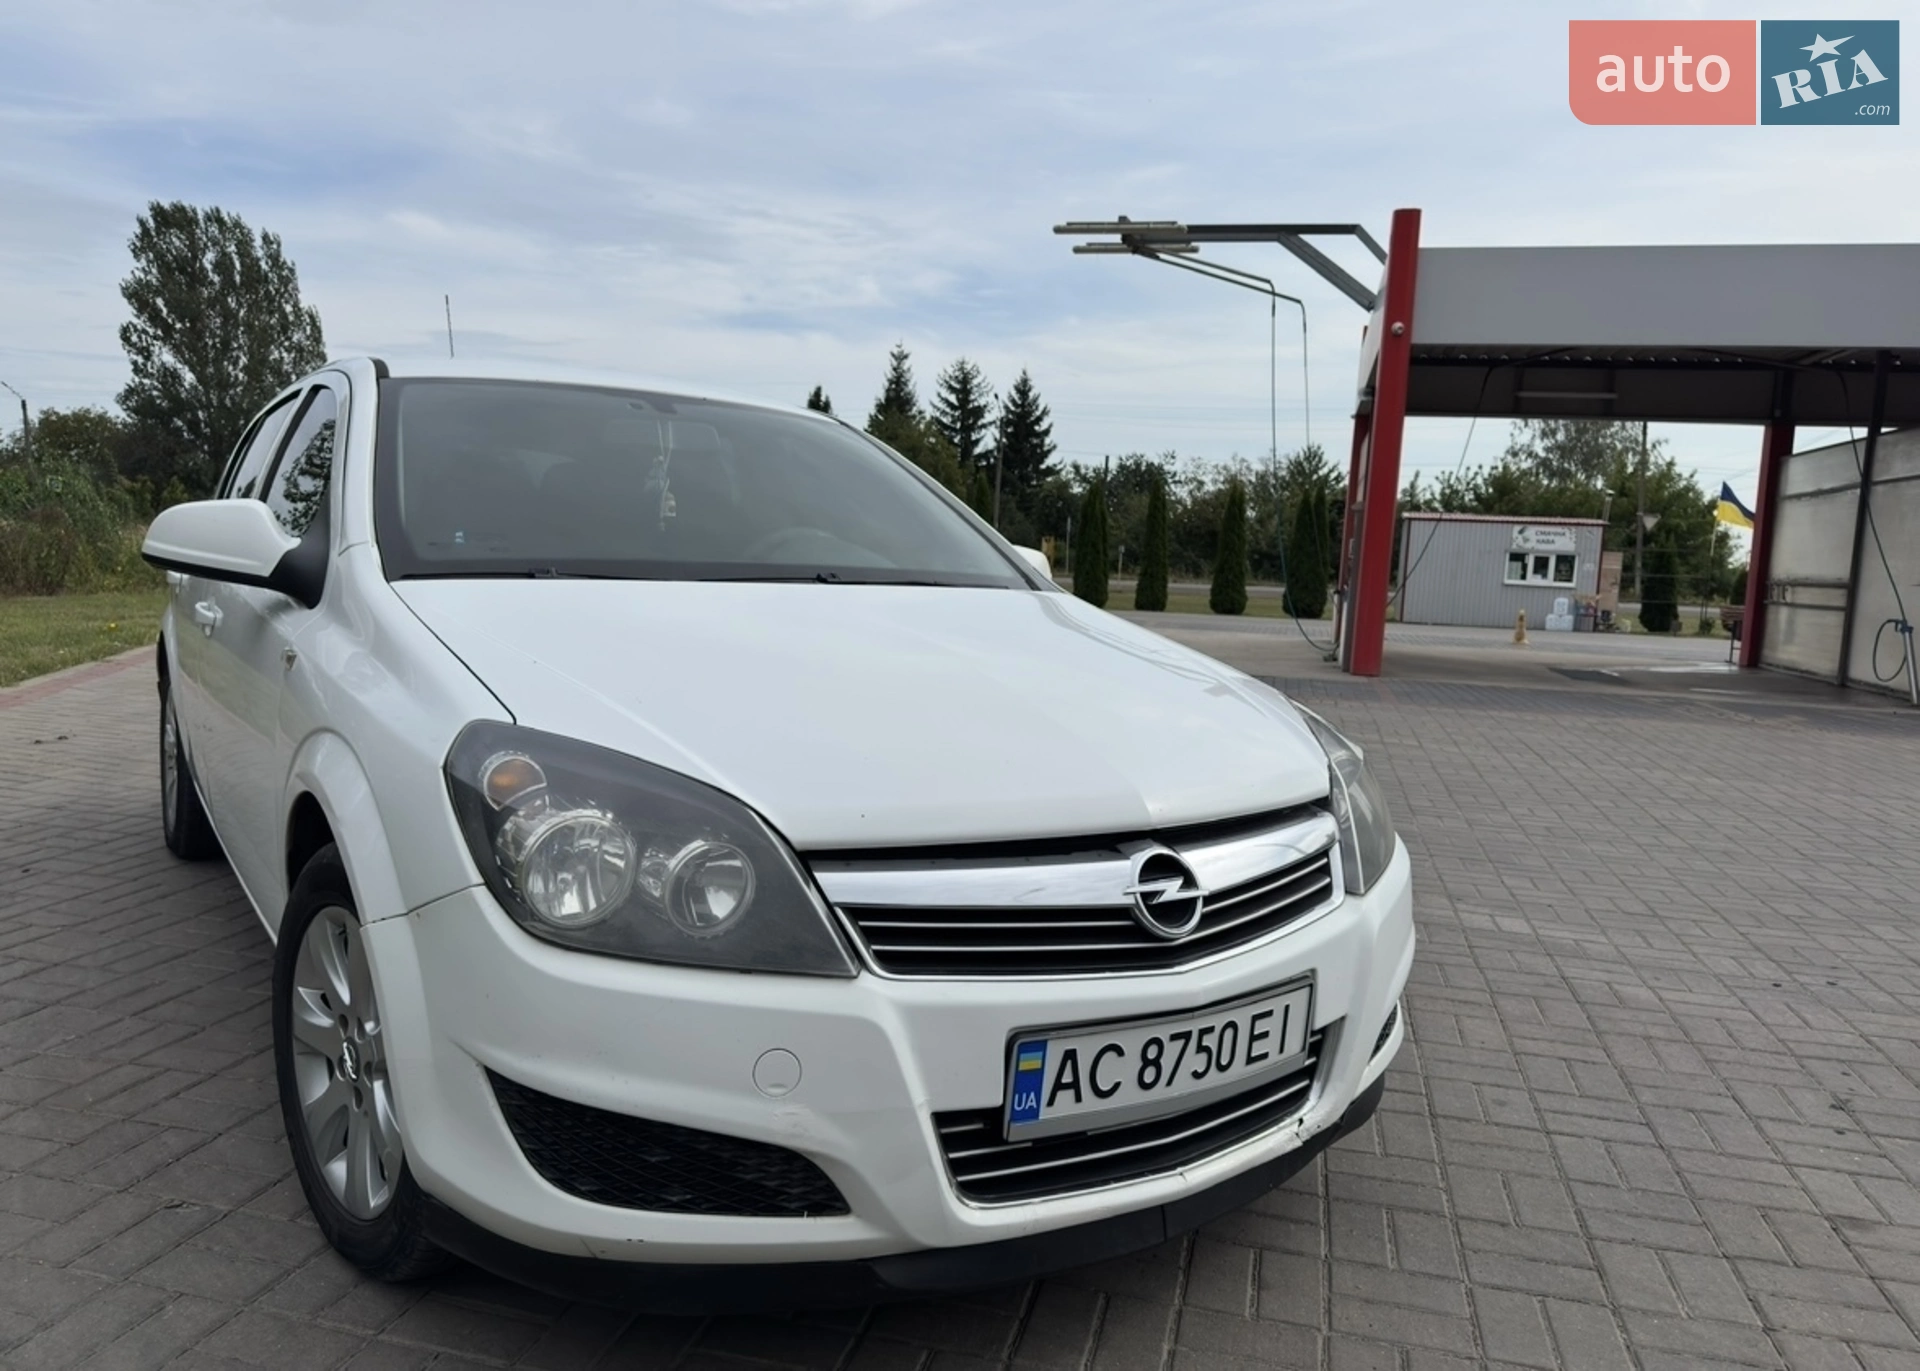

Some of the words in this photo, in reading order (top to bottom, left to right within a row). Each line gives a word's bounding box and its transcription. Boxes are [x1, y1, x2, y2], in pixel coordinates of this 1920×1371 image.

[1046, 1043, 1126, 1107] AC
[1137, 1020, 1239, 1090] 8750
[1014, 1092, 1037, 1111] UA
